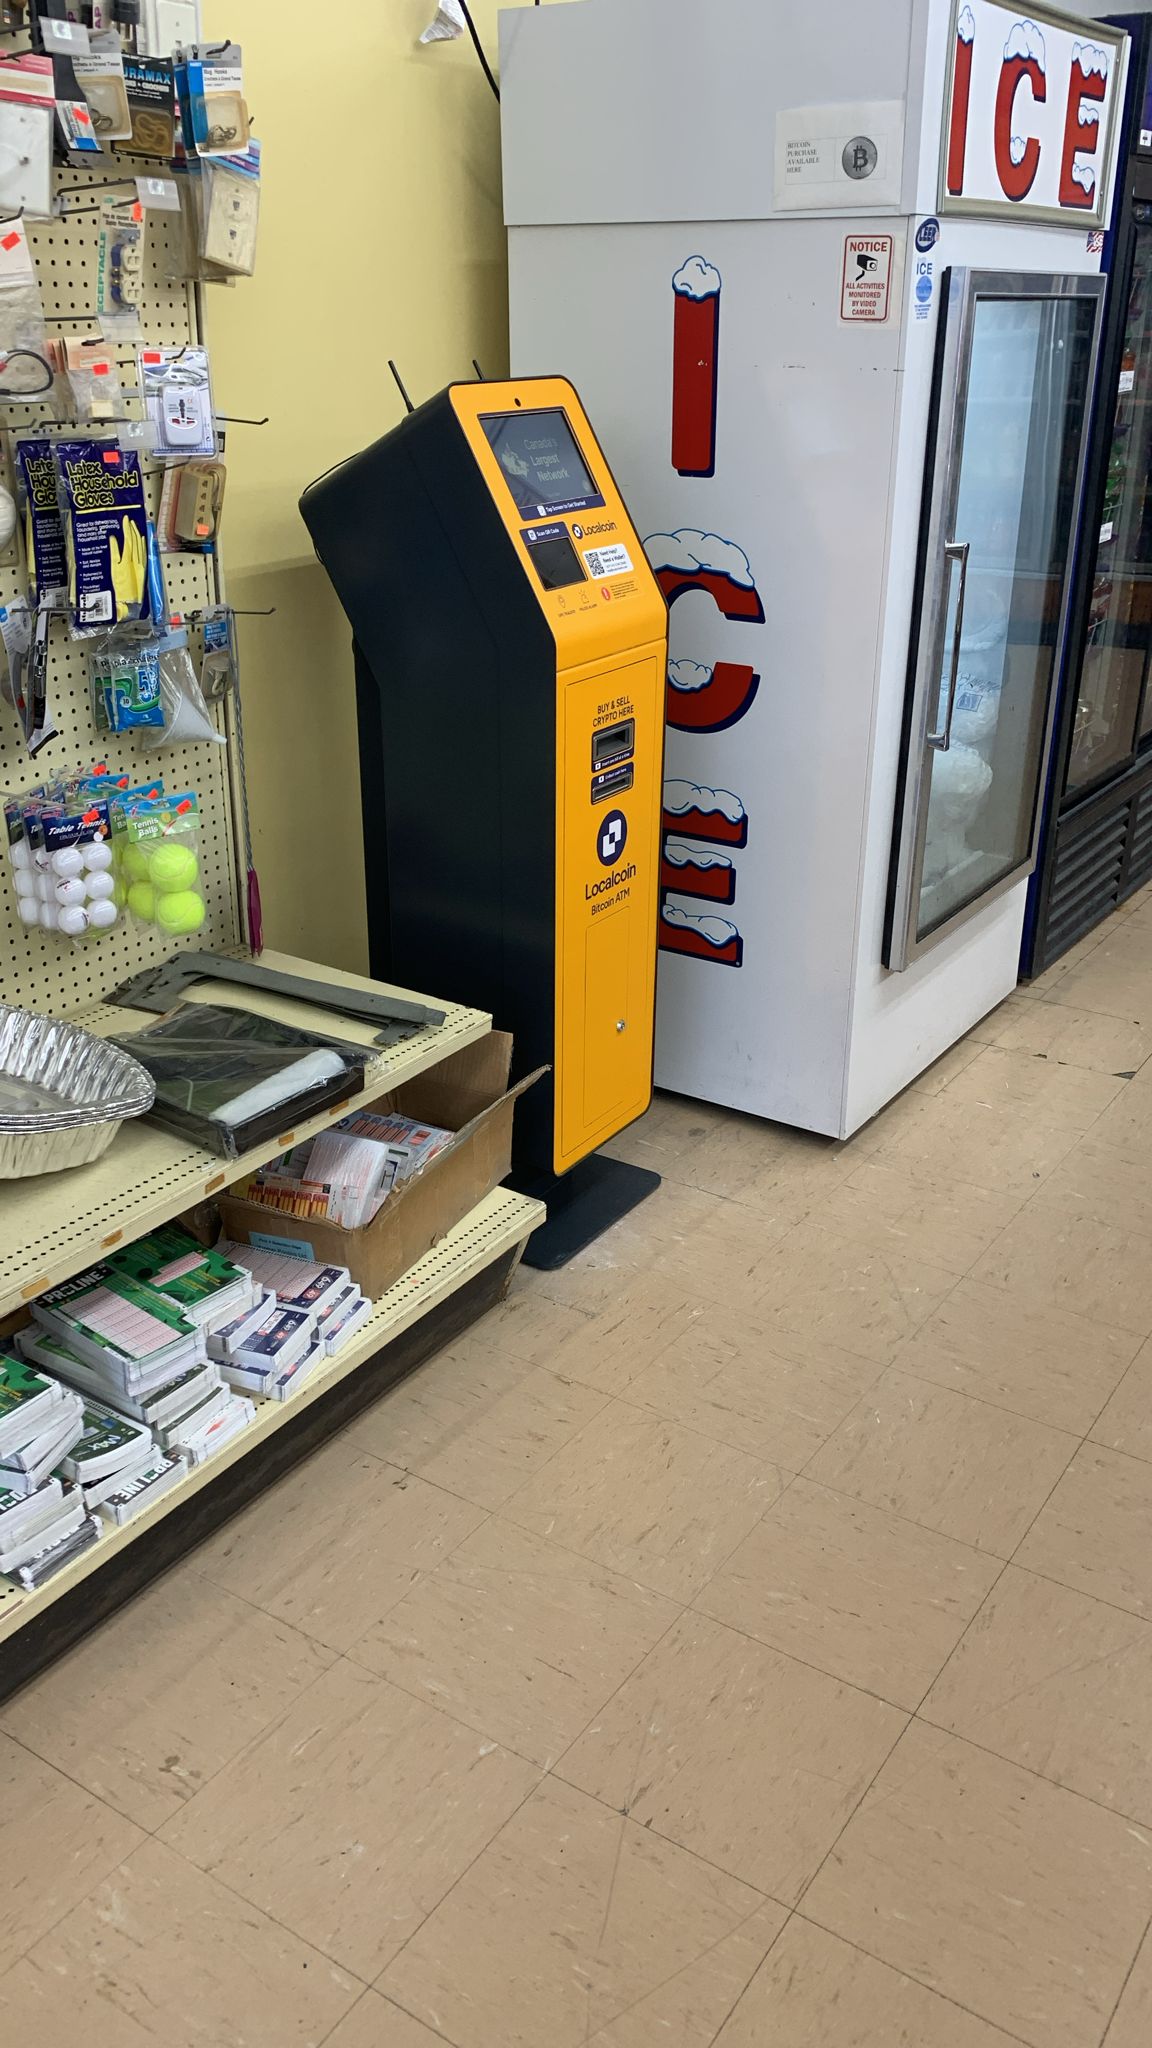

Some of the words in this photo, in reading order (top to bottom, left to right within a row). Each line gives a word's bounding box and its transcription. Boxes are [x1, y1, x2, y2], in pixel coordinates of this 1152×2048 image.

[124, 66, 171, 85] URAMAX
[947, 5, 1107, 210] ICE
[787, 141, 811, 149] BITCOIN
[787, 149, 817, 157] PURCHASE
[787, 157, 820, 166] AVAILABLE
[849, 241, 888, 253] NOTICE
[97, 231, 107, 313] ECEPTACLE
[916, 263, 933, 275] ICE
[846, 282, 855, 290] ALL
[856, 282, 885, 290] ACTIVITIES
[848, 291, 881, 299] MONITORED
[524, 438, 558, 450] Canada's
[26, 458, 54, 474] Late
[530, 454, 560, 467] Largest
[66, 461, 101, 476] Latex
[536, 467, 571, 482] Network
[70, 471, 138, 492] Household
[75, 492, 114, 507] Gloves
[582, 520, 618, 536] Localcoin
[597, 703, 610, 714] BUY
[610, 700, 615, 709] &
[616, 695, 630, 707] SELL
[592, 710, 618, 727] CRYPTO
[618, 704, 634, 718] HERE
[49, 824, 75, 836] Table
[77, 818, 107, 830] Tennis
[132, 818, 159, 830] Tennis
[138, 826, 158, 837] Balls
[585, 862, 637, 901] Localcoin
[591, 896, 614, 916] Bitcoin
[615, 887, 630, 904] ATM
[42, 1266, 105, 1303] PROLINE
[87, 1434, 122, 1452] MAX
